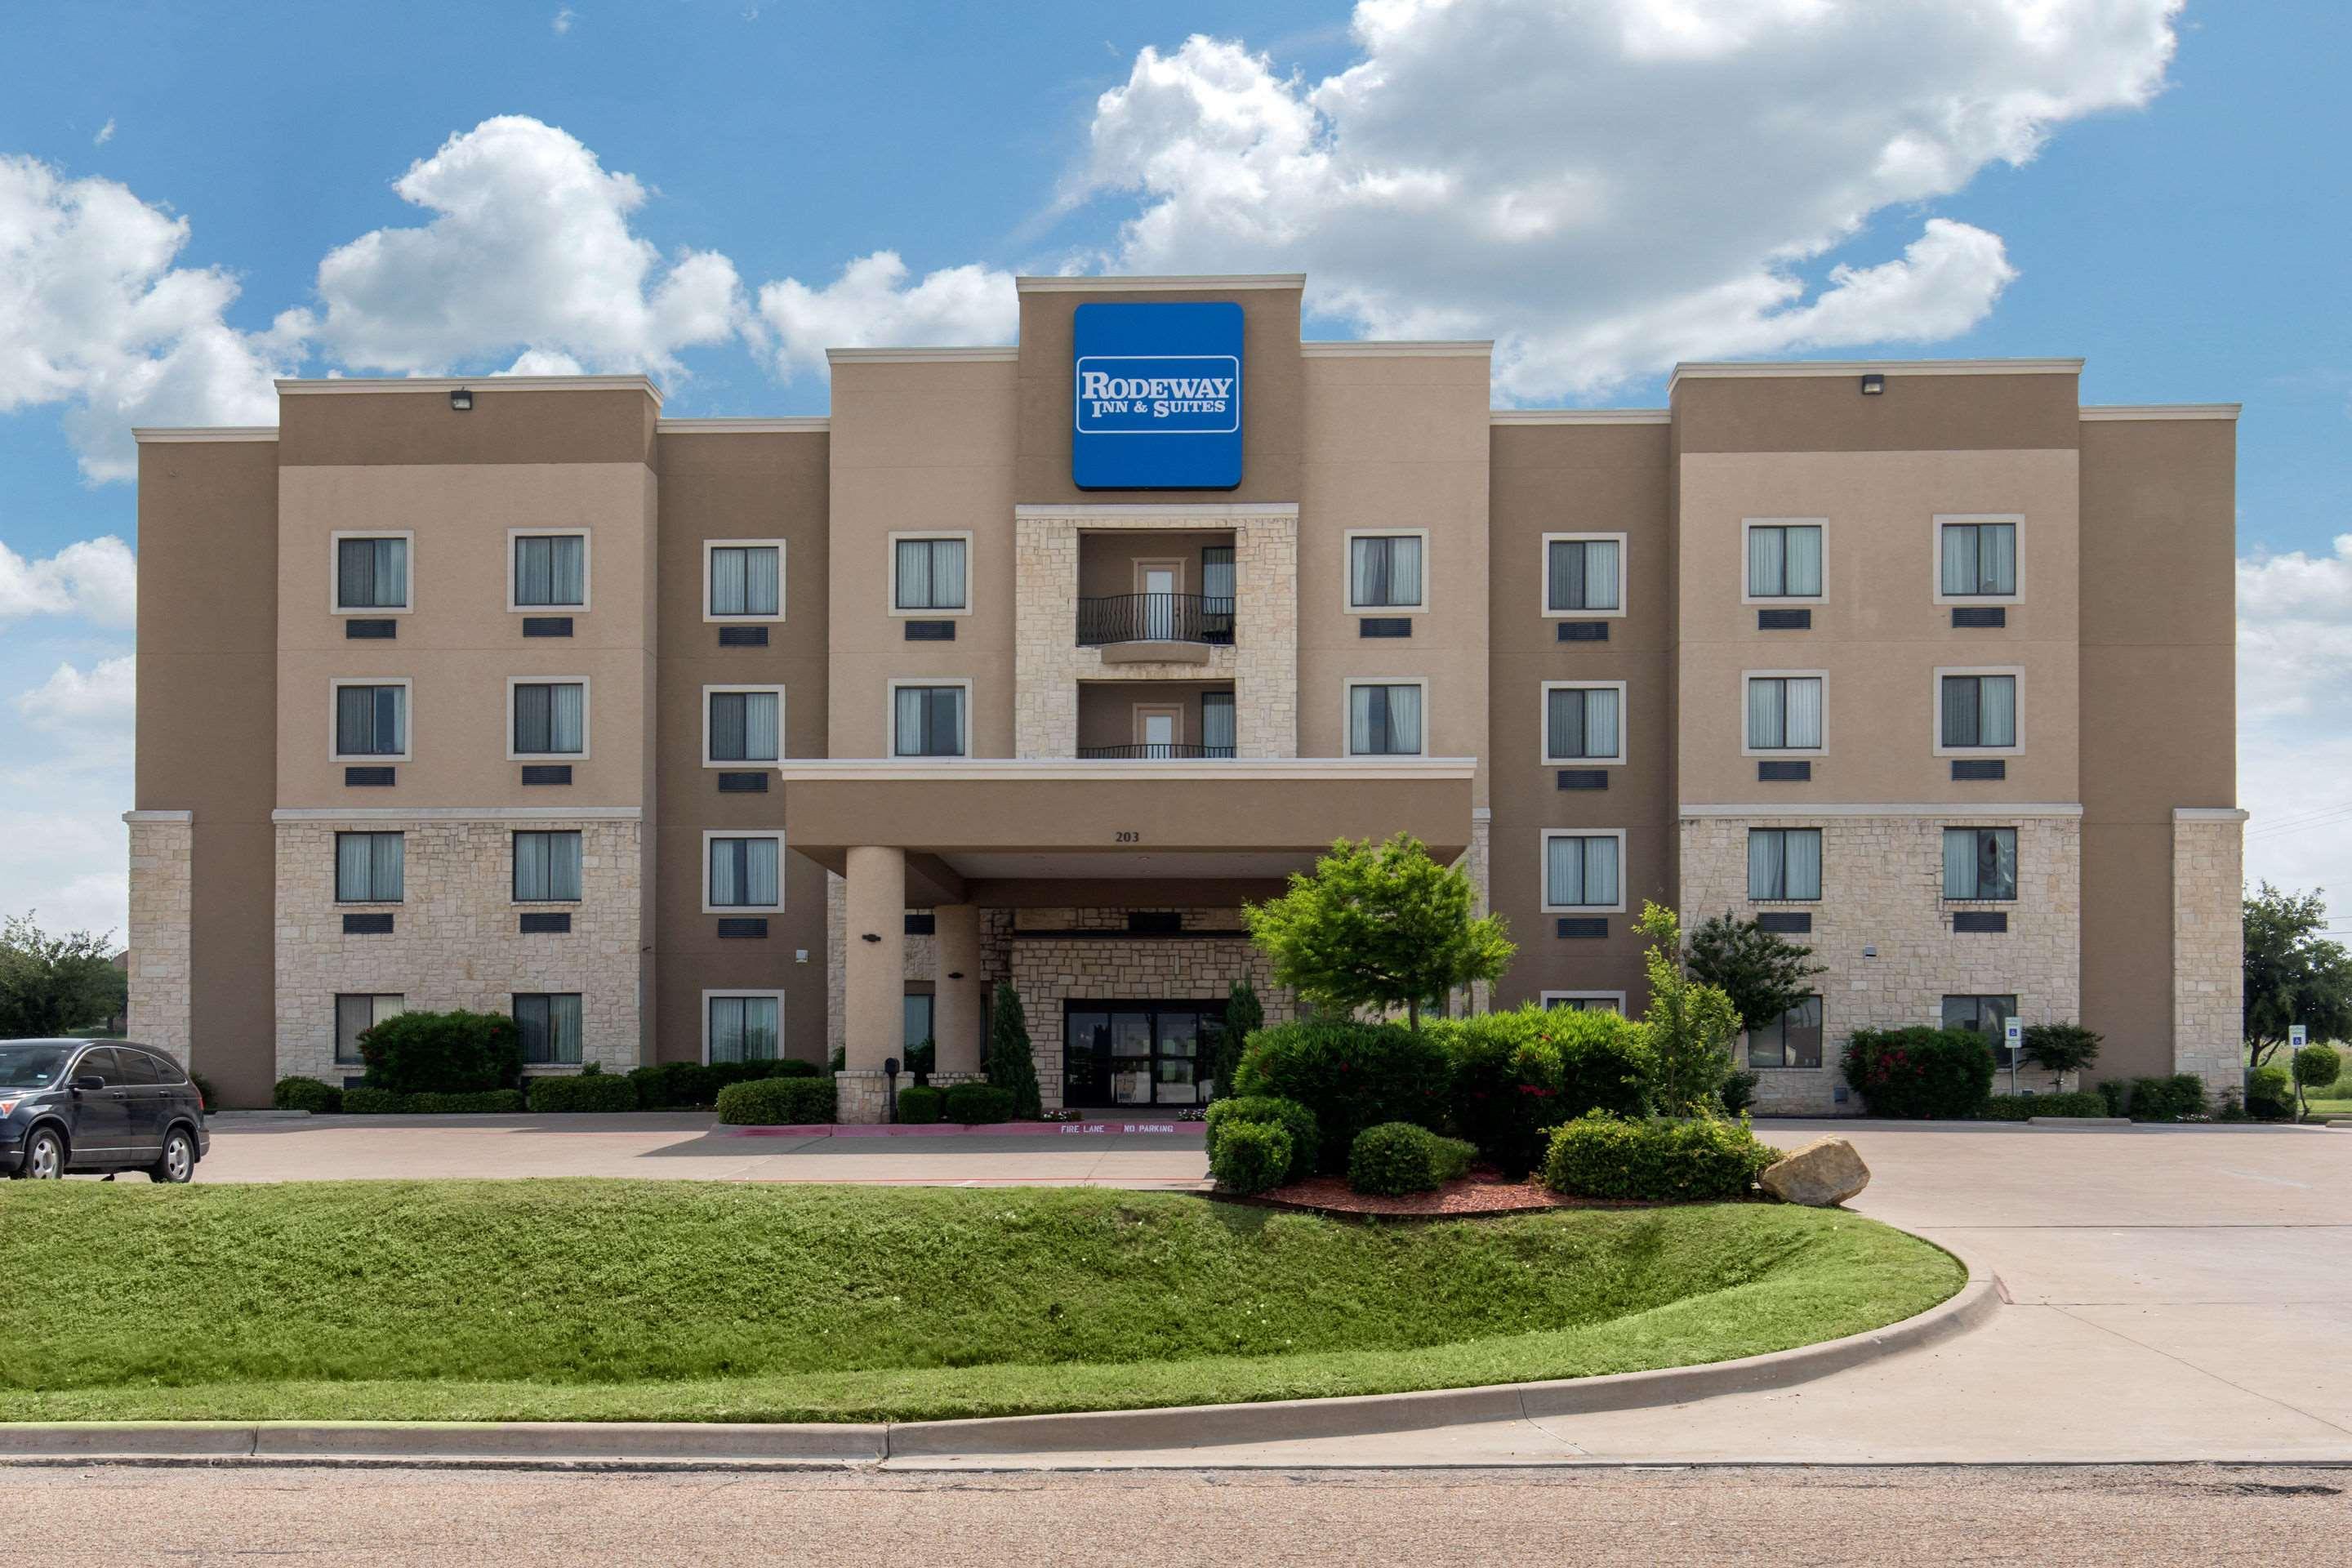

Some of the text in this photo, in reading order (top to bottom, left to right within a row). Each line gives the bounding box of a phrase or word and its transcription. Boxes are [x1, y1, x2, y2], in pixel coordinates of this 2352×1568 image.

[1082, 372, 1233, 399] RODEWAY
[1092, 400, 1226, 418] INN & SUITES
[1116, 831, 1139, 842] 203
[1062, 1125, 1104, 1133] FIRE LANE
[1124, 1125, 1174, 1133] NO PARKING
